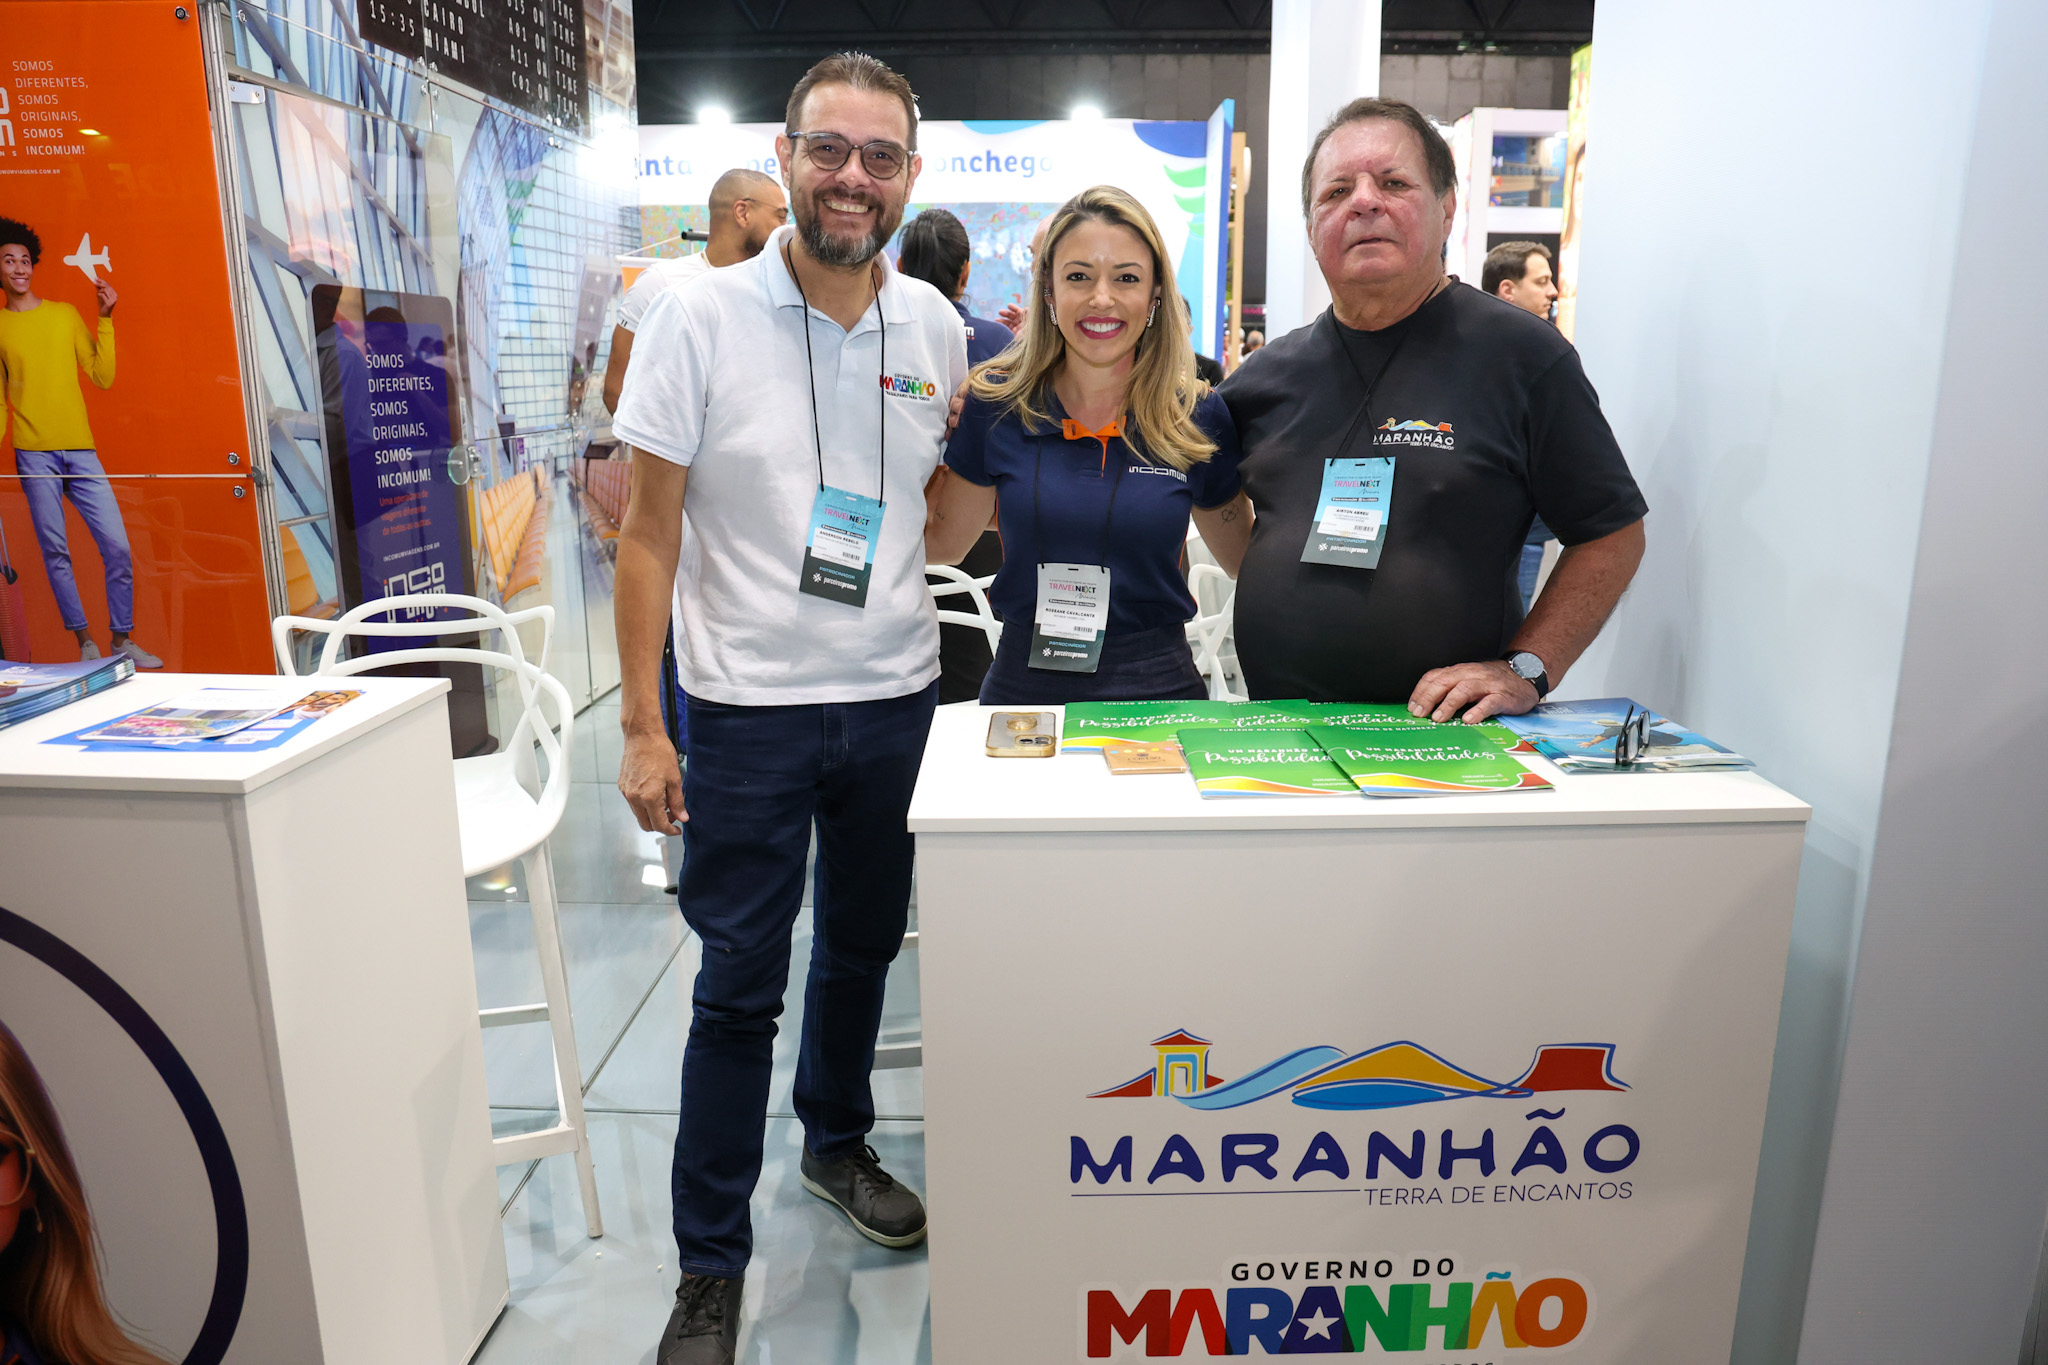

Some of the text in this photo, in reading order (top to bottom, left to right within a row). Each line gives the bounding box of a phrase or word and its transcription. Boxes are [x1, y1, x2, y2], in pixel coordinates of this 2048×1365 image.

[533, 6, 545, 27] ON
[553, 20, 575, 47] TIME
[369, 0, 415, 37] 15:35
[424, 27, 465, 64] MIAMI
[511, 70, 530, 94] C02
[424, 0, 464, 35] CAIRO
[510, 44, 529, 68] A11
[537, 58, 548, 79] ON
[556, 70, 577, 95] TIME
[508, 17, 576, 71] A01 ON TIME
[12, 60, 54, 71] SOMOS
[15, 77, 89, 88] DIFERENTES,
[17, 94, 59, 105] SOMOS
[20, 111, 82, 122] ORIGINAIS,
[22, 128, 64, 138] SOMOS
[25, 145, 86, 155] INCOMUM!
[366, 354, 405, 369] SOMOS
[368, 376, 434, 393] DIFERENTES,
[879, 374, 936, 397] MARANHÃO
[370, 400, 409, 417] SOMOS
[372, 422, 428, 441] ORIGINAIS,
[1373, 432, 1454, 446] MARANHÃO
[374, 447, 413, 465] SOMOS
[377, 468, 431, 489] INCOMUM!
[1334, 480, 1381, 488] TRAVELNEXT
[824, 507, 870, 526] TRAVELNEXT
[1049, 582, 1097, 594] TRAVELNEXT
[1080, 715, 1219, 729] Possibilidades
[1345, 748, 1497, 762] Possibilidades
[1069, 1106, 1641, 1185] MARANHÃO
[1364, 1181, 1634, 1207] TERRA DE ENCANTOS
[1230, 1257, 1455, 1282] GOVERNO DO
[1087, 1271, 1588, 1358] MARANHÃO
